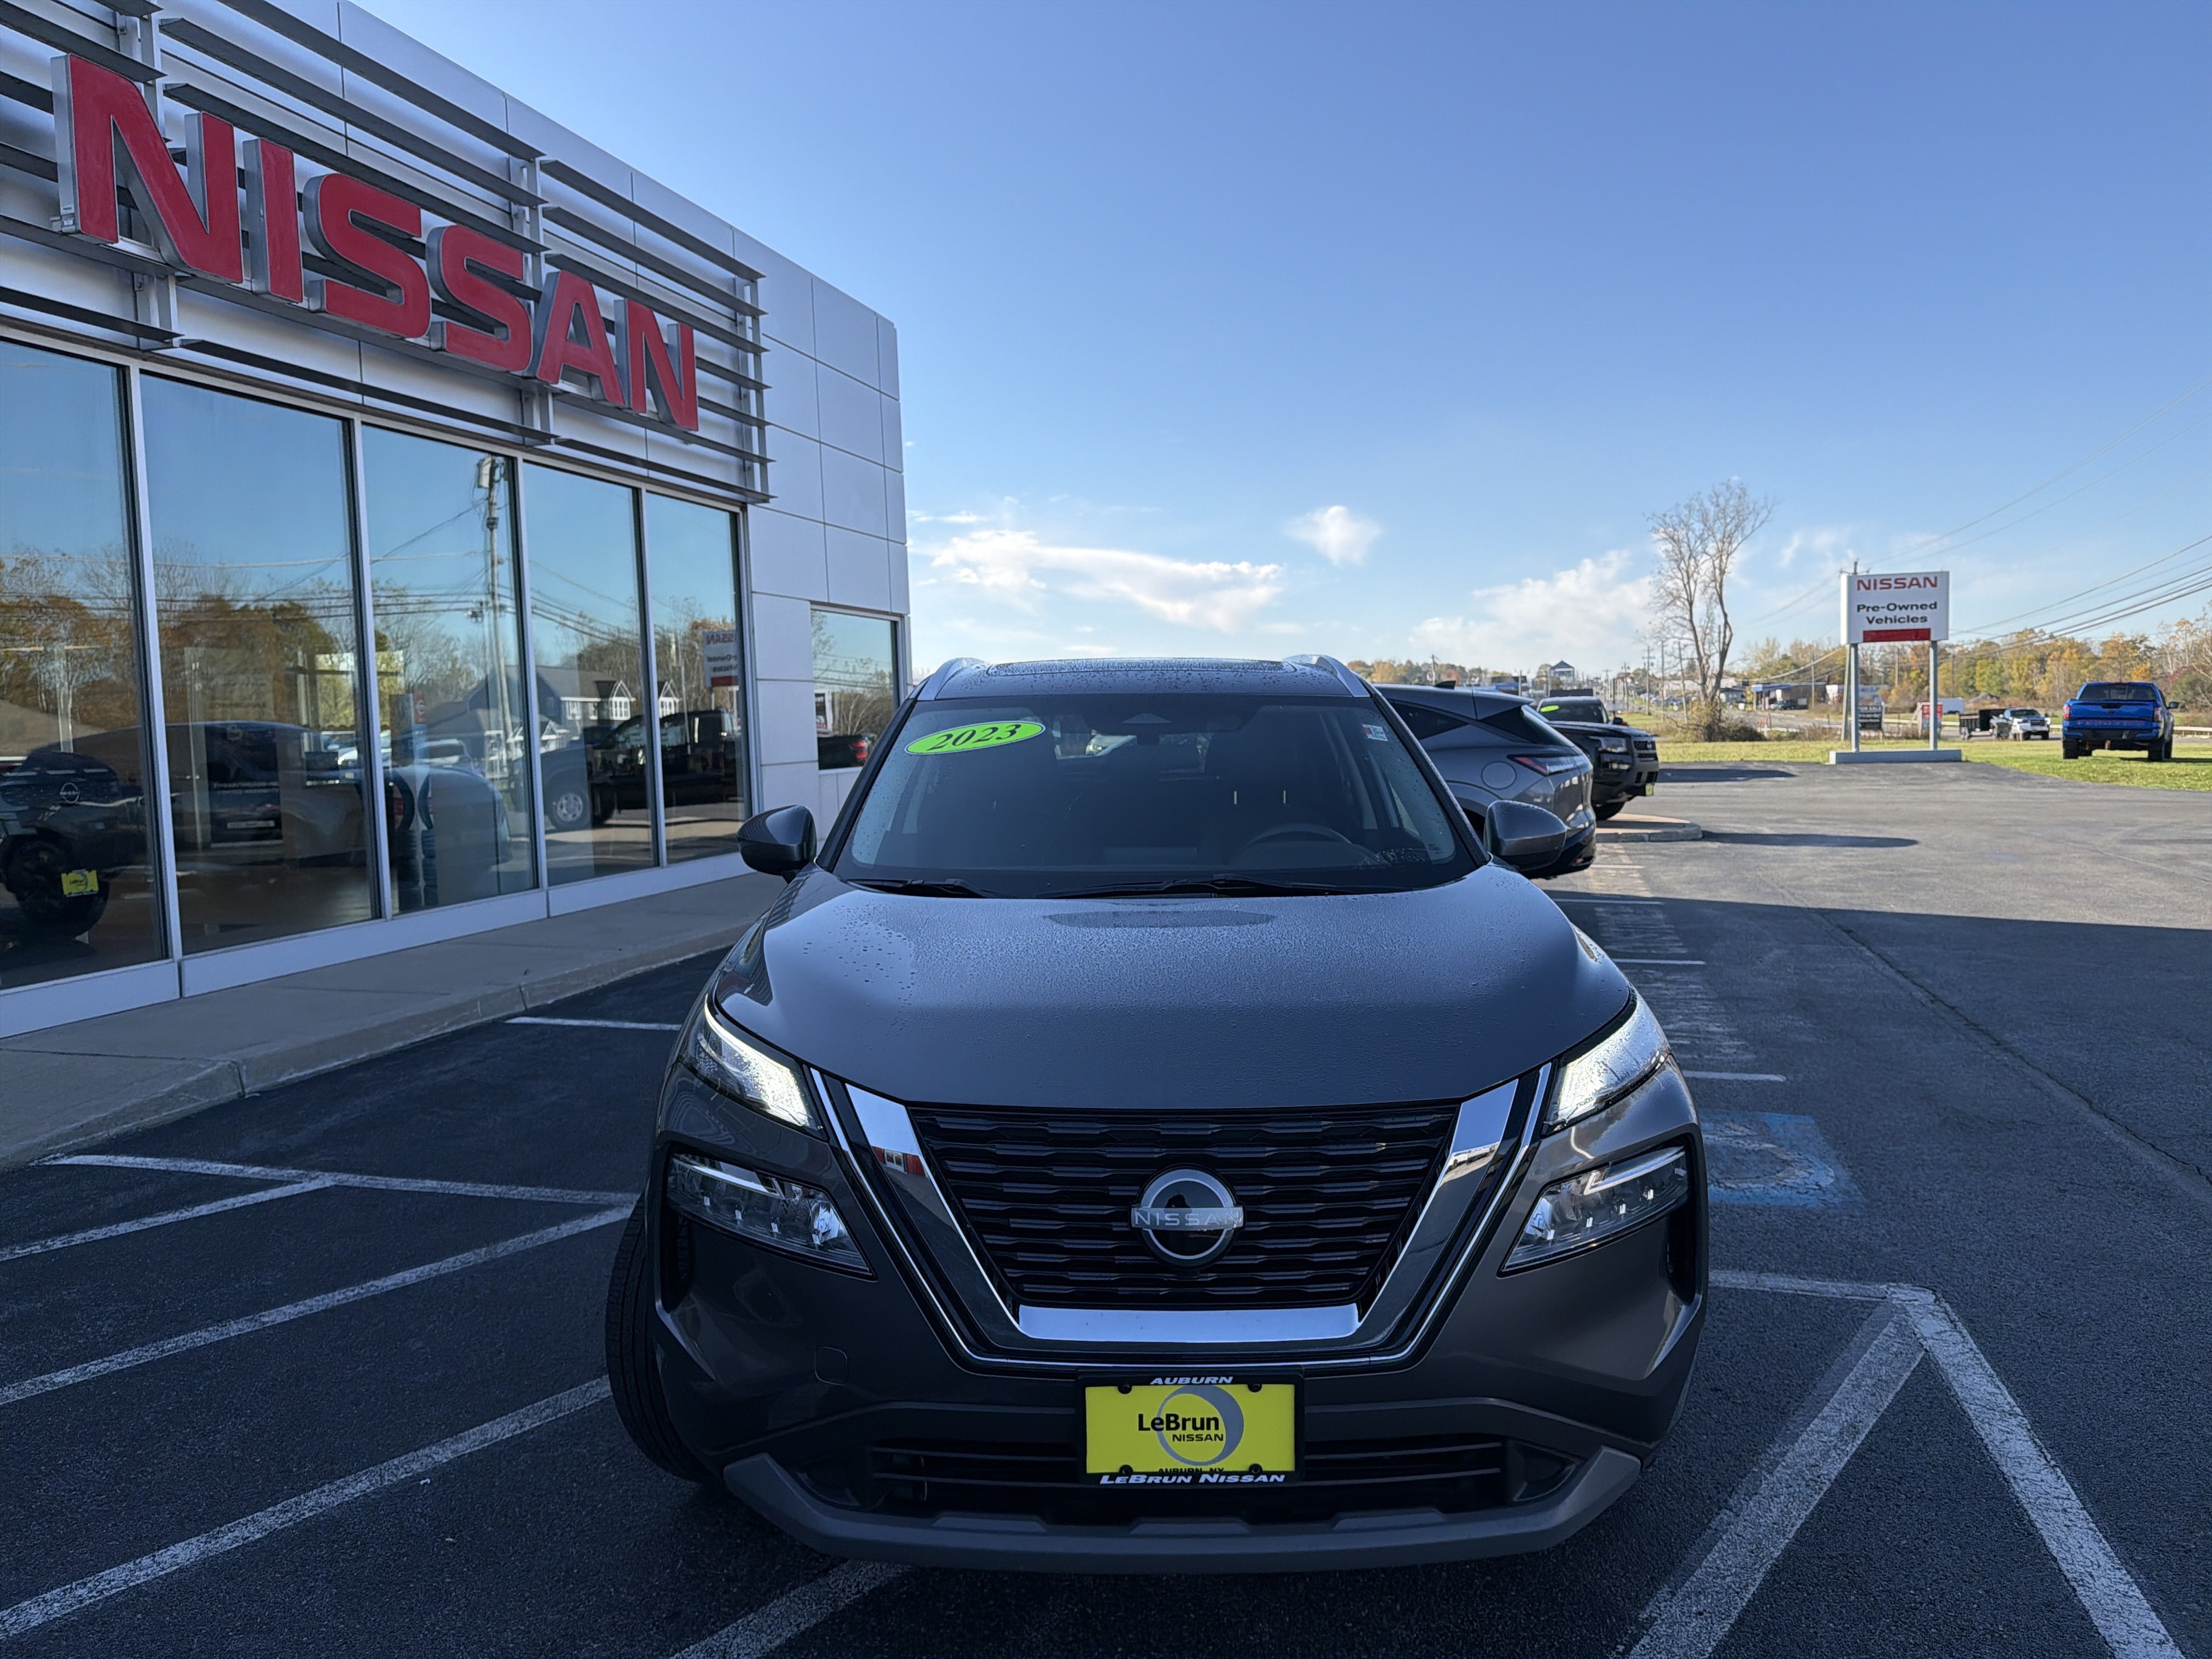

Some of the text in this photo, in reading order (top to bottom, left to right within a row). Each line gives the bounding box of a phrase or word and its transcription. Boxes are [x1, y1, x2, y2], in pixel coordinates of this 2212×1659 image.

[68, 53, 699, 431] NISSAN
[1857, 576, 1938, 591] NISSAN
[1857, 601, 1938, 612] Pre-Owned
[1866, 615, 1928, 624] Vehicles
[926, 724, 1022, 752] 2023
[1134, 1211, 1240, 1226] NISSAN
[1149, 1376, 1234, 1385] AUBURN
[1138, 1413, 1220, 1431] LeBrun
[1172, 1434, 1223, 1442] NISSAN
[1198, 1474, 1285, 1483] NISSAN
